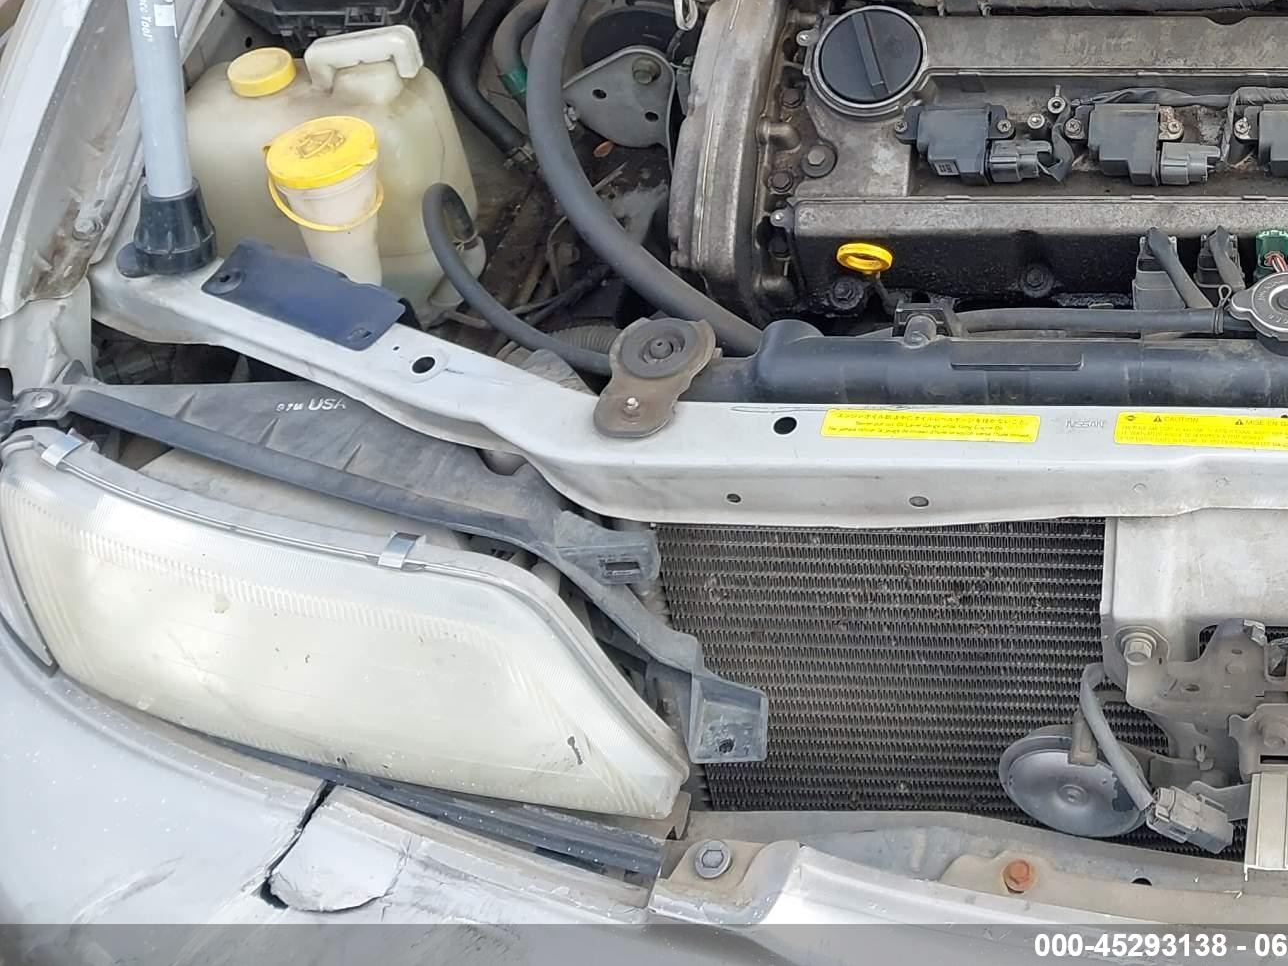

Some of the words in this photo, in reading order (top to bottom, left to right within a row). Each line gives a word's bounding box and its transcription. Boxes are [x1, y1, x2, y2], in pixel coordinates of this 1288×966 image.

[308, 397, 347, 411] USA
[1065, 418, 1105, 430] NISSAN
[1164, 416, 1200, 424] CAUTION
